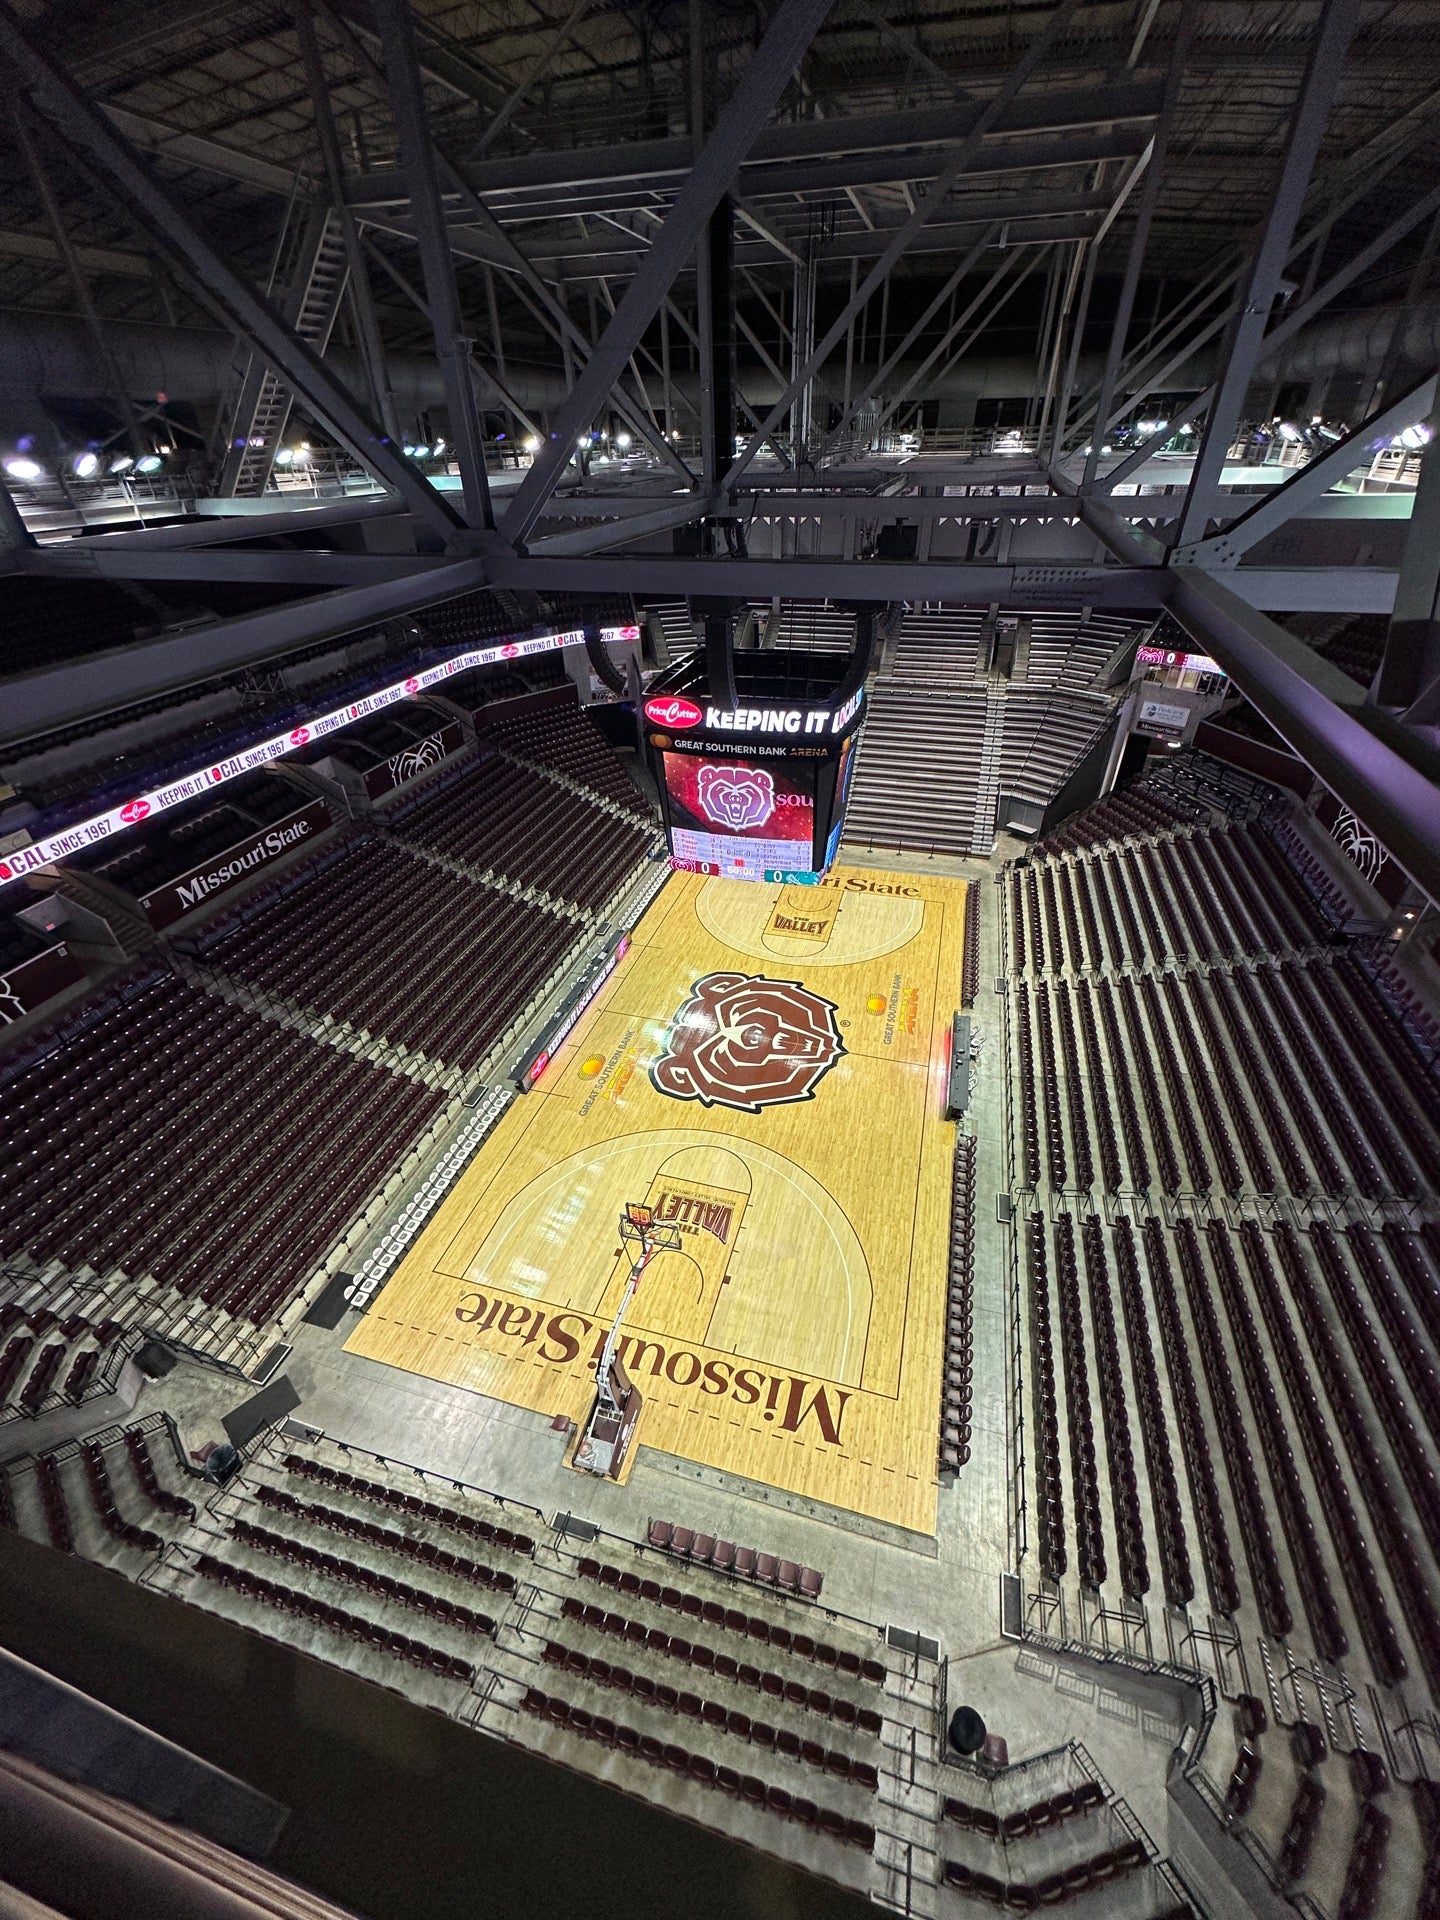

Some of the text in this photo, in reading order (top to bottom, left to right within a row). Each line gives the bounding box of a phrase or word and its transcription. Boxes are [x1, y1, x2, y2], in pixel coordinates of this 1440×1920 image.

[523, 642, 545, 654] KEEPING
[546, 640, 551, 649] IT
[552, 634, 579, 648] LOCAL
[603, 631, 614, 641] 967
[1166, 652, 1176, 664] 0
[422, 669, 440, 686] KEEPING
[439, 668, 445, 677] IT
[444, 659, 465, 676] LOCAL
[464, 653, 480, 668] SINCE
[481, 651, 496, 662] 1967
[314, 687, 402, 735] KEEPING IT LOCAL SINCE 1967
[705, 707, 802, 734] KEEPING
[805, 711, 830, 733] IT
[674, 739, 829, 757] GREAT SOUTHERN BANK ARENA
[157, 740, 285, 807] KEEPING IT LOCAL SINCE 1967
[0, 819, 113, 882] OCAL SINCE 1967
[175, 820, 309, 910] Missouri State
[701, 862, 710, 874] 0
[727, 866, 755, 877] 60:00
[773, 871, 783, 882] 0
[844, 878, 919, 897] State
[774, 914, 829, 935] VALLEY
[548, 1022, 573, 1056] KEEPING
[576, 991, 593, 1014] LOCAL
[591, 968, 609, 992] SINCE
[884, 974, 902, 1045] GREAT SOUTHERN BANK
[899, 988, 920, 1034] ARENA
[579, 1029, 636, 1117] GREAT SOUTHERN BANK
[652, 1191, 734, 1246] VALLEY
[454, 1292, 593, 1364] State
